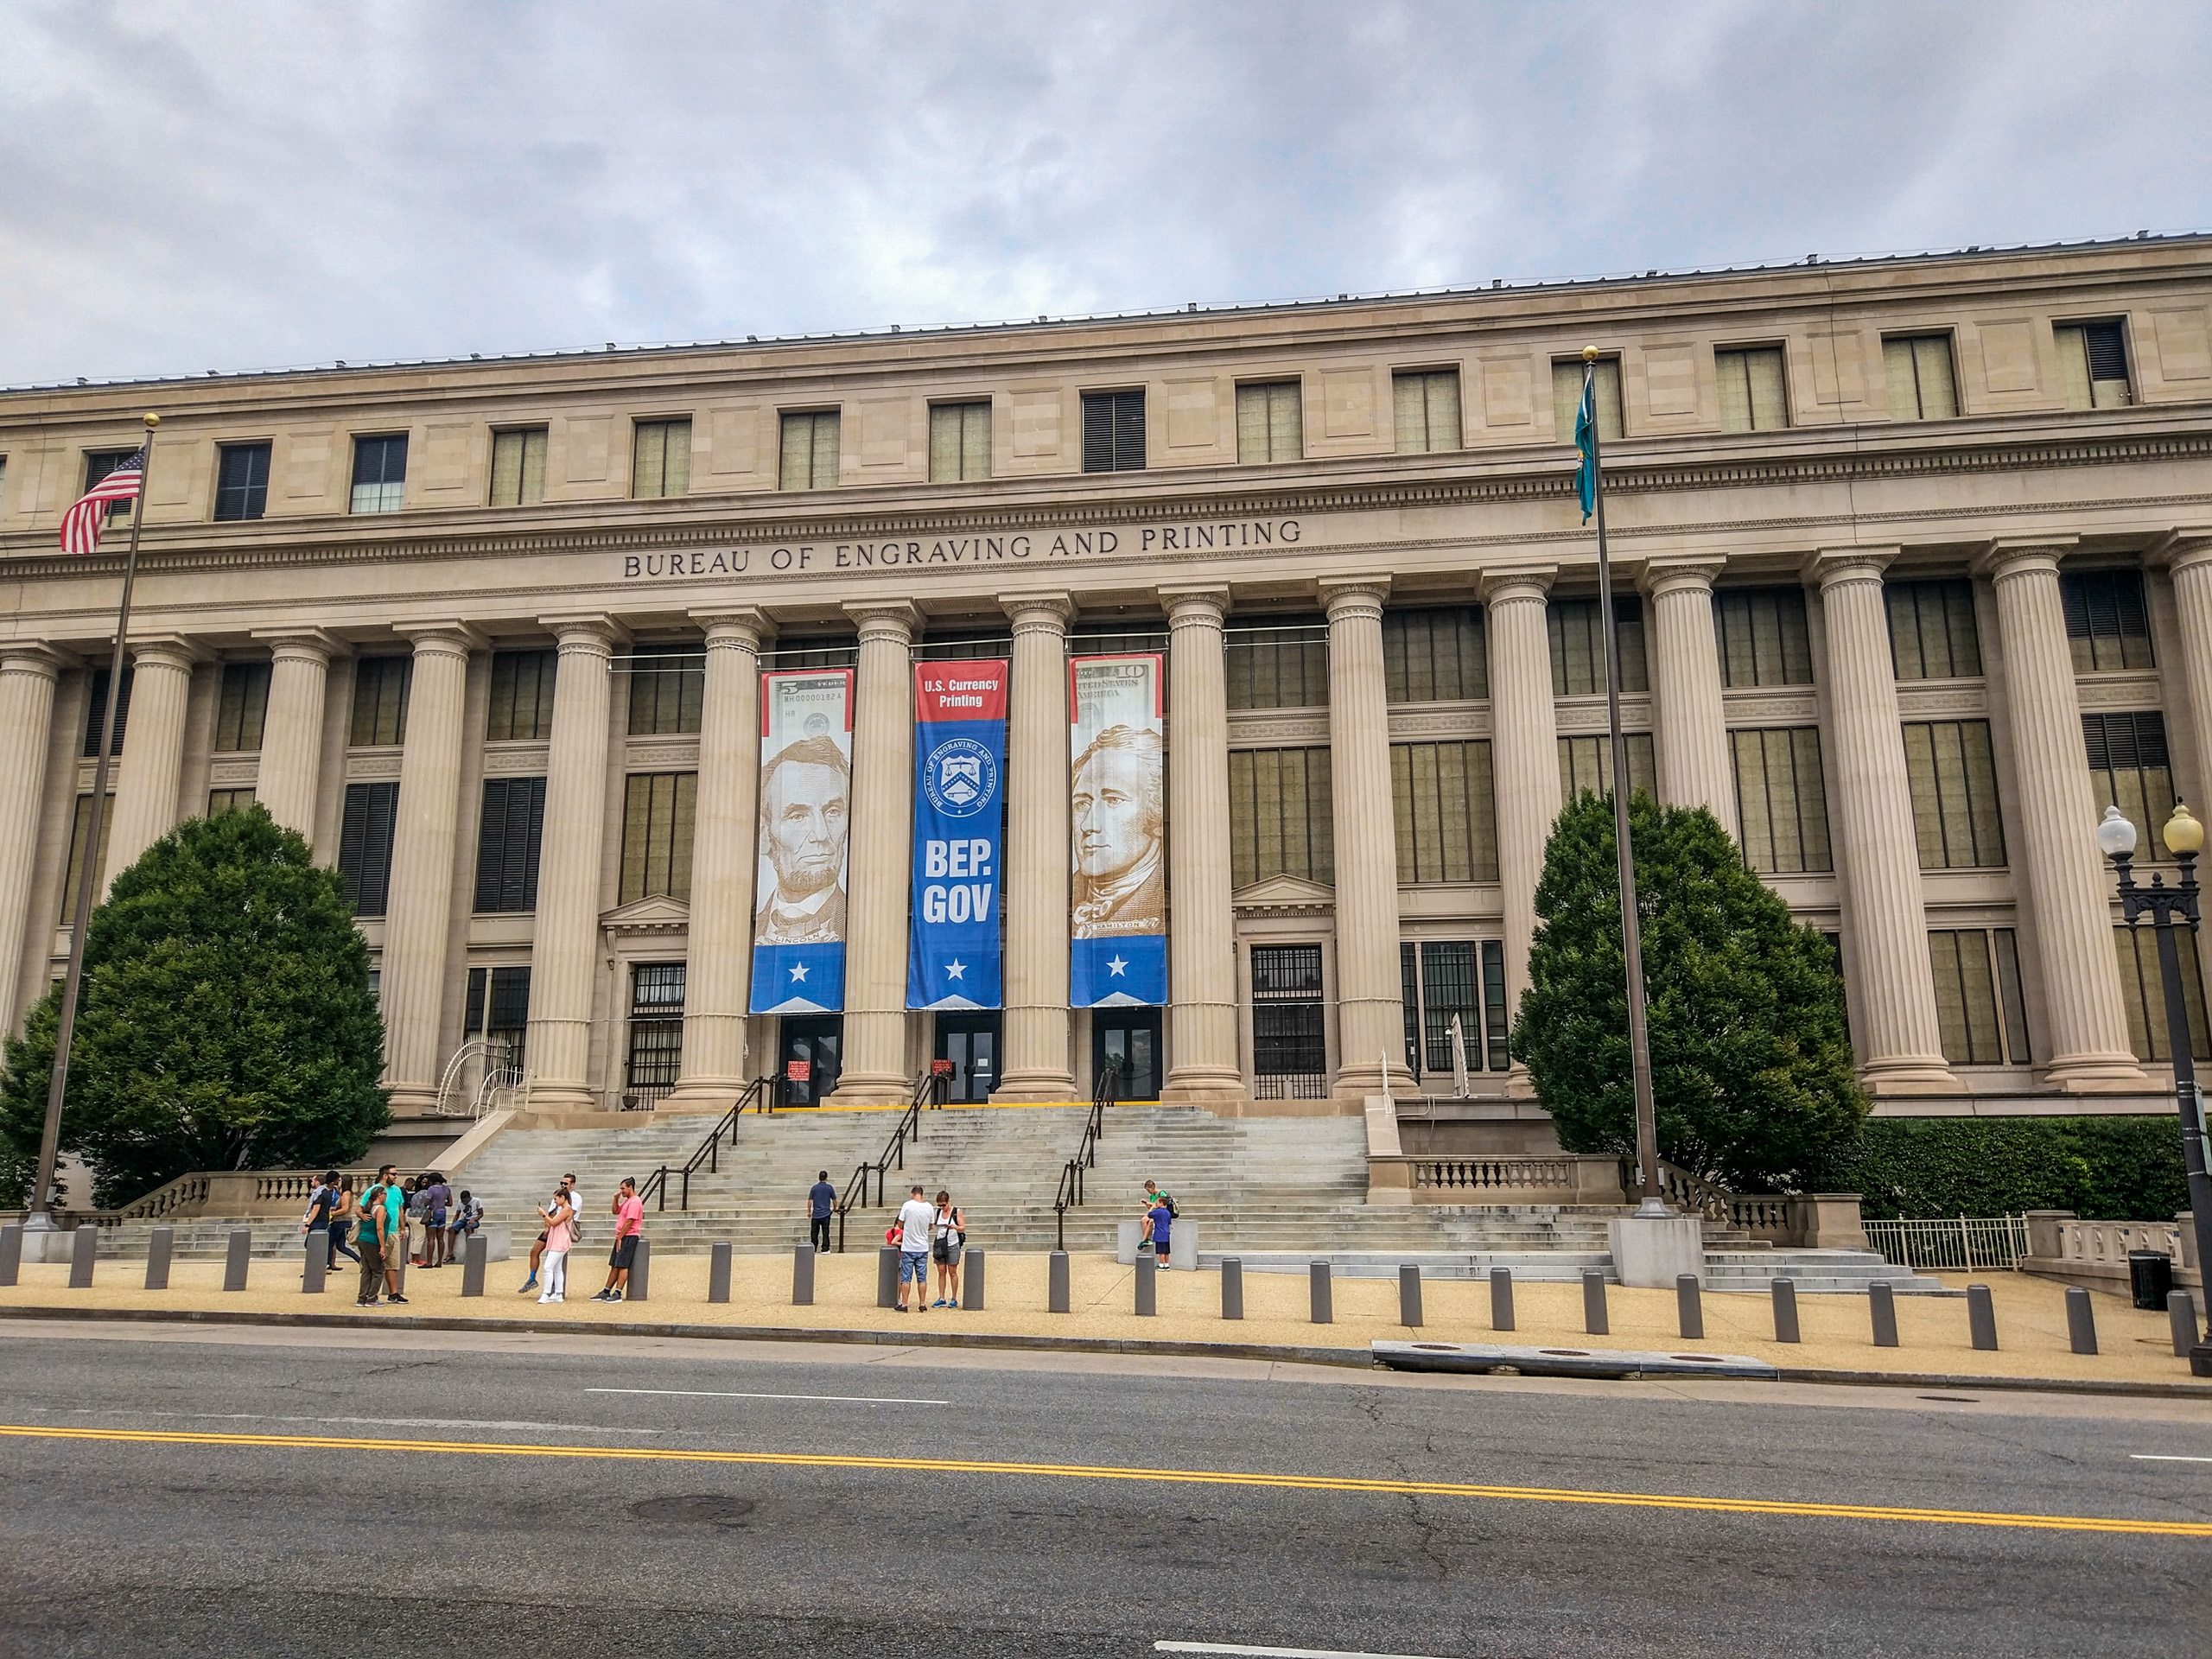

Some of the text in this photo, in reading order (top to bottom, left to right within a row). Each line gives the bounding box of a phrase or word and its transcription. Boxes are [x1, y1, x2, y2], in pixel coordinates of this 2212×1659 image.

[625, 520, 1300, 577] BUREAU OF ENGRAVING AND PRINTING
[1116, 664, 1145, 678] 10
[779, 682, 798, 695] 5
[925, 679, 998, 692] U.S. Currency
[939, 695, 982, 708] Printing
[926, 741, 994, 807] BUREAU OF ENGRAVING AND PRINTING
[925, 838, 991, 877] BEP.
[924, 883, 992, 924] GOV
[775, 932, 820, 944] LINCOLN
